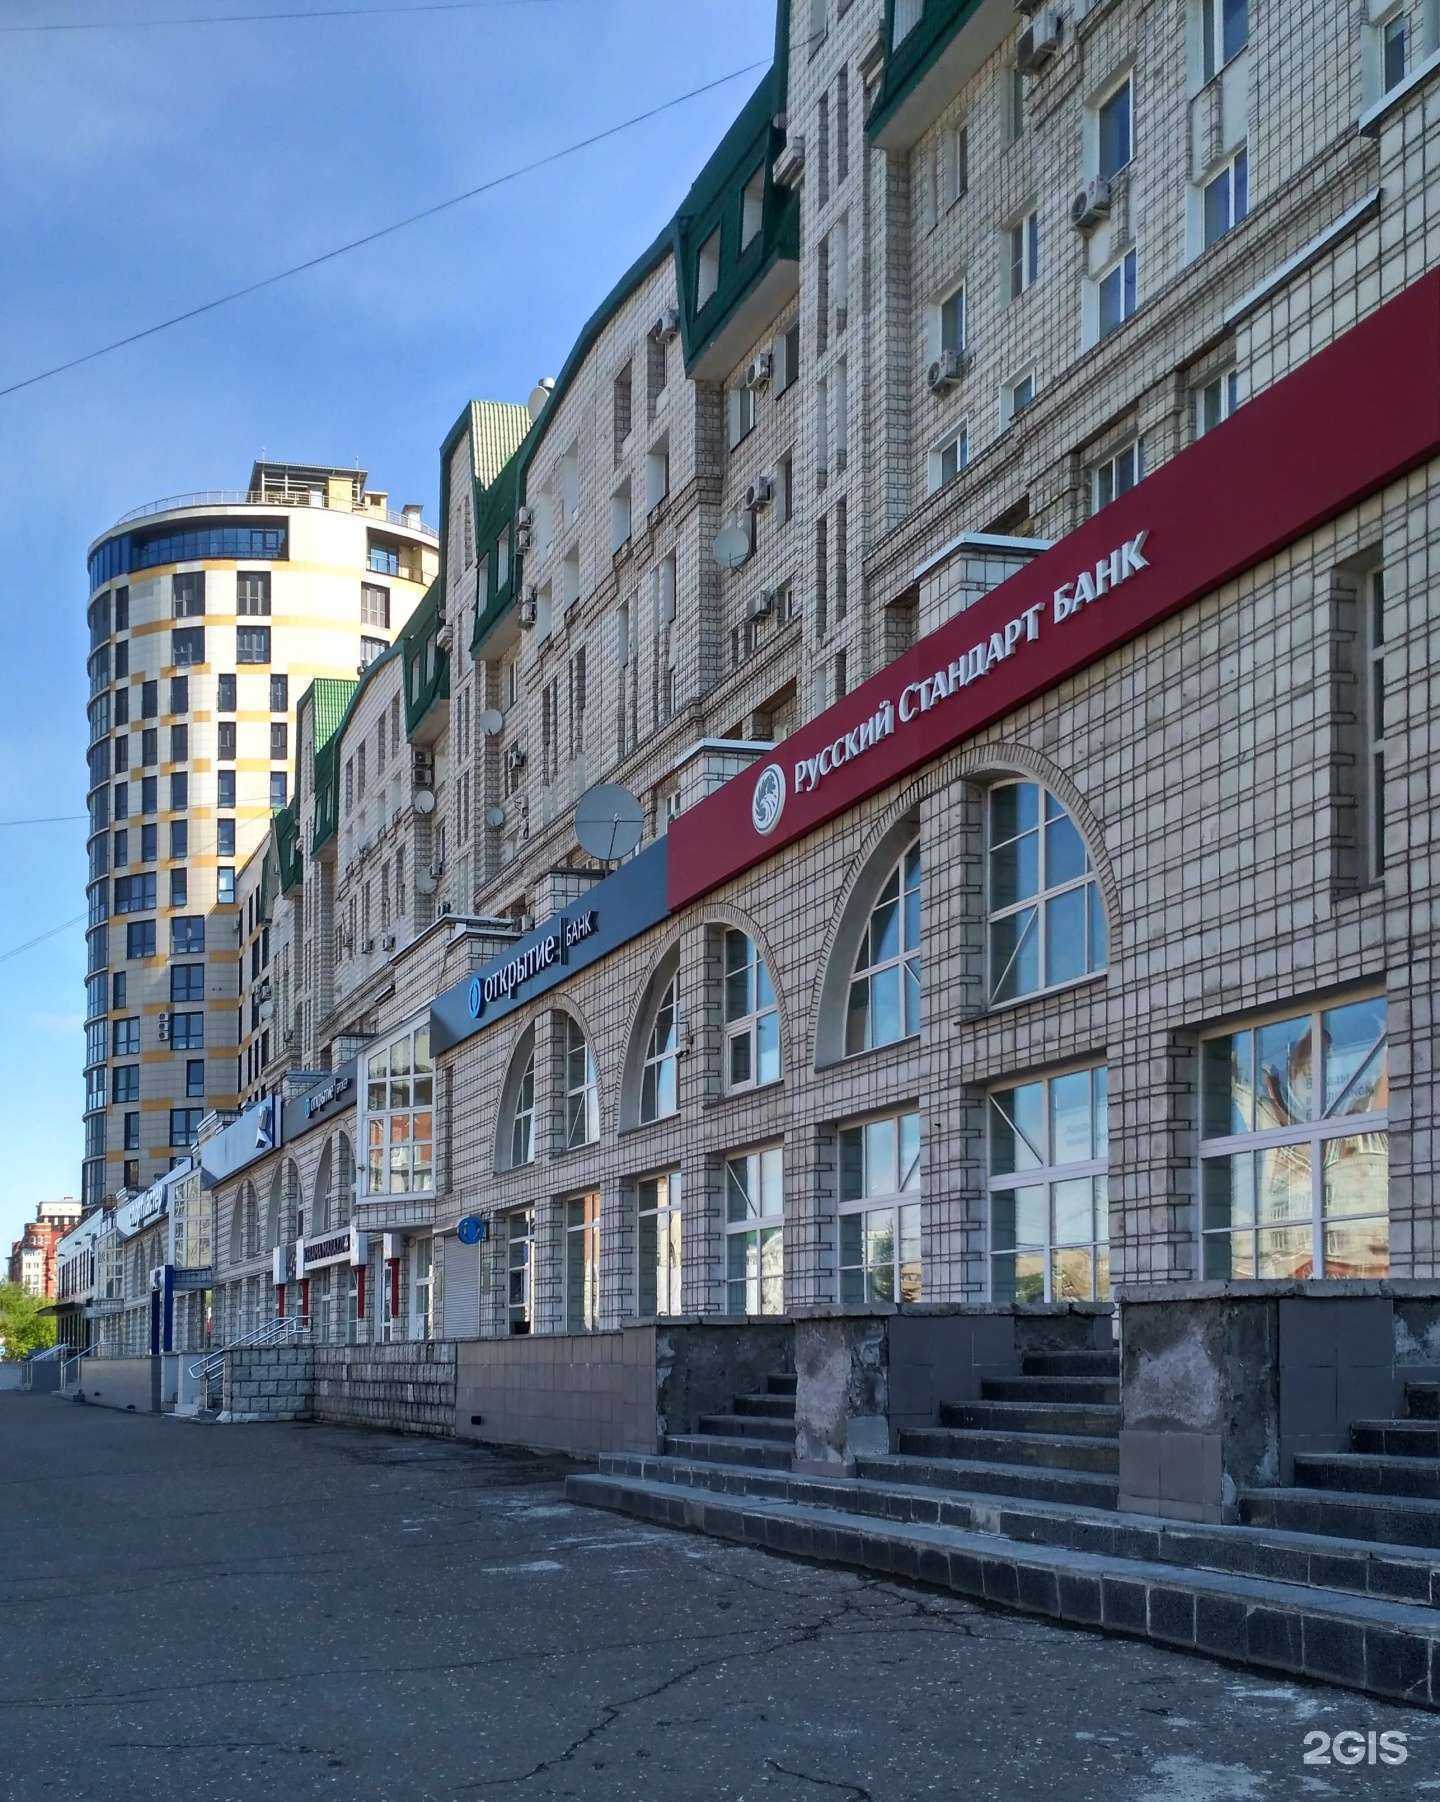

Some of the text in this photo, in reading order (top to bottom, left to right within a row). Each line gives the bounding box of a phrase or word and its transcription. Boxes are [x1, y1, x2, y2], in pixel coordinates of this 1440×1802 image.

[899, 601, 1046, 723] СТАНДАРТ
[1053, 529, 1151, 625] БАНК
[566, 911, 594, 947] БАНК
